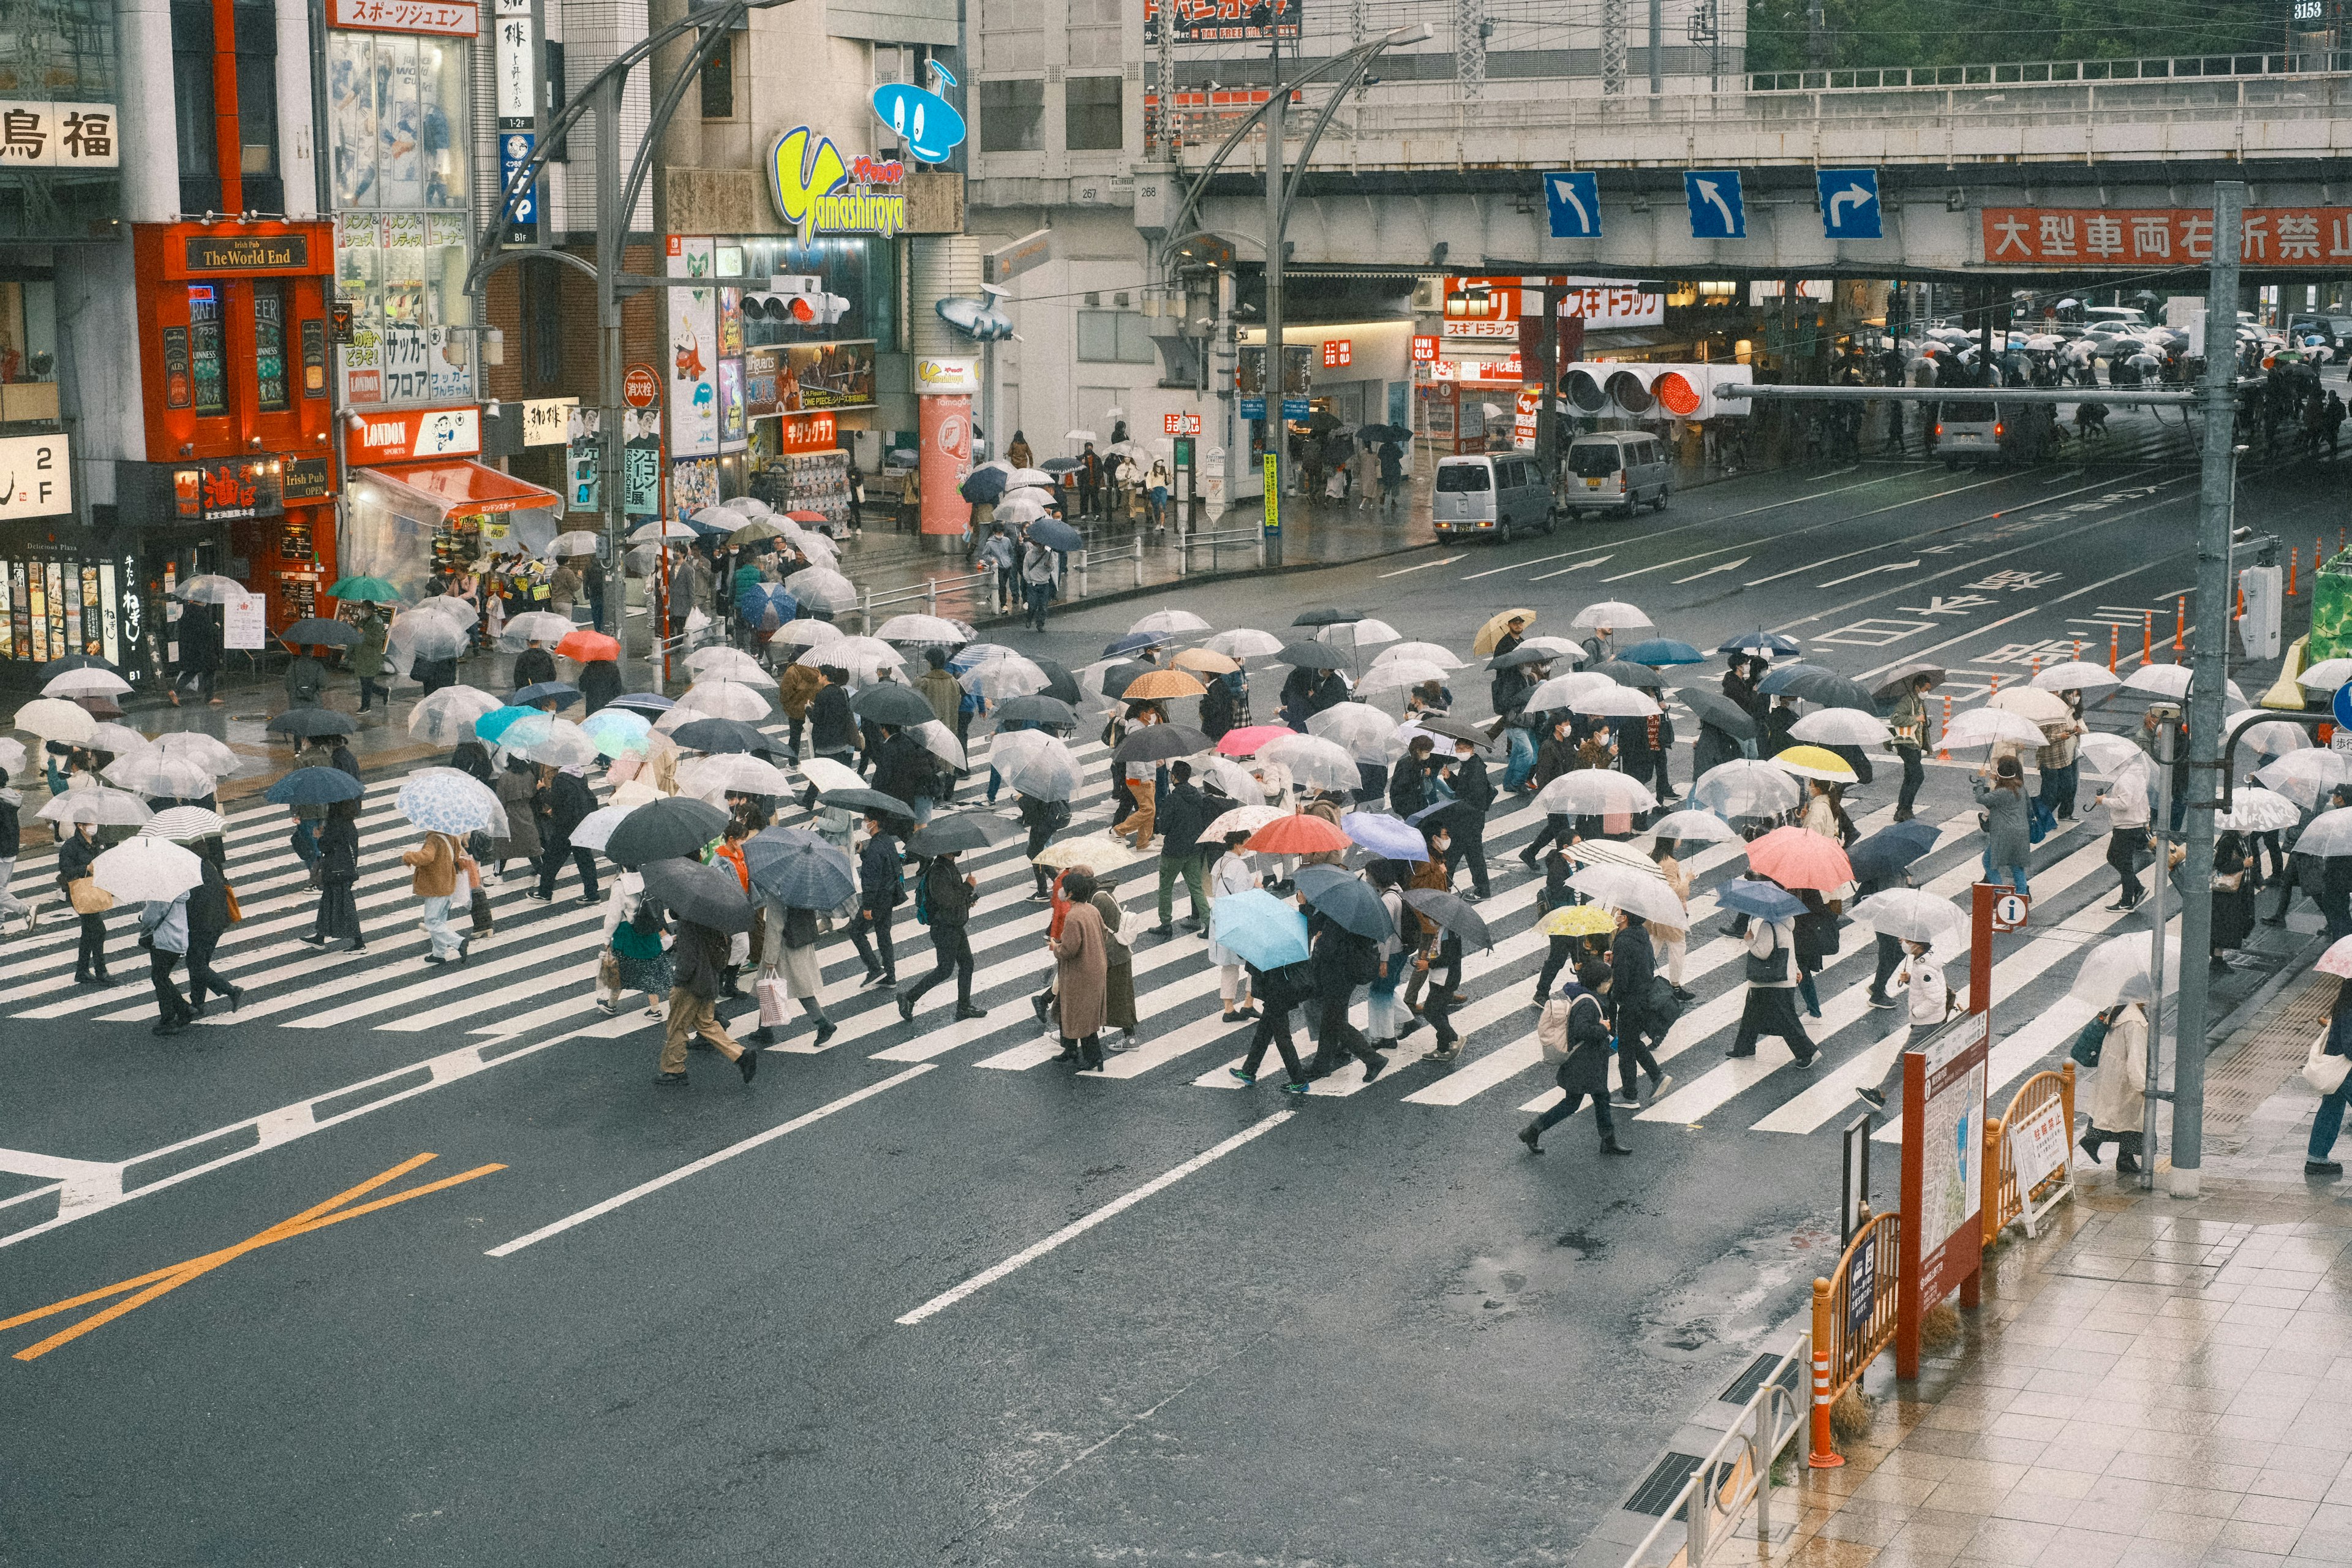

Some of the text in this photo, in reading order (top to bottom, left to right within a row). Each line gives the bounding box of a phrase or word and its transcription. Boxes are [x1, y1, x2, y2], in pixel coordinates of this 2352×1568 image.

[352, 1, 463, 28] スポーツジュエン
[2294, 2, 2321, 19] 3153
[1202, 29, 1217, 39] TAX
[1219, 28, 1243, 38] FREE
[509, 119, 525, 128] 1-2F
[0, 108, 110, 159] 鳥福
[774, 126, 905, 251] Yamashiroya
[1083, 189, 1096, 198] 267
[1142, 187, 1156, 197] 268
[393, 232, 423, 247] レディース
[432, 232, 464, 244] コーナー
[515, 233, 526, 242] B1F
[203, 249, 290, 265] The World End
[254, 299, 276, 319] EER
[198, 326, 217, 336] クラフト
[344, 330, 383, 348] の階へ
[1414, 338, 1431, 349] UNI
[256, 347, 277, 356] UINNESS
[386, 331, 426, 365] サッカー
[1325, 344, 1335, 354] ユニ
[1340, 342, 1349, 353] UNI
[192, 350, 216, 359] UINNESS
[1325, 354, 1335, 364] クロ
[1340, 353, 1350, 364] QLO
[1414, 349, 1433, 360] QLO
[1496, 362, 1522, 372] 化粧品
[431, 372, 470, 385] サッカー
[919, 361, 963, 388] Yamashiroya
[350, 376, 379, 393] LONDON
[388, 371, 428, 400] フロア
[627, 382, 652, 397] 消火栓
[363, 422, 406, 448] LONDON
[286, 472, 324, 486] Irish Pub
[631, 450, 646, 505] シーレ展
[306, 486, 324, 496] OPEN
[481, 502, 516, 512] ロンドンスポーツ
[124, 555, 135, 587] 牛たん
[104, 609, 116, 640] ねぎし
[129, 671, 140, 681] B1
